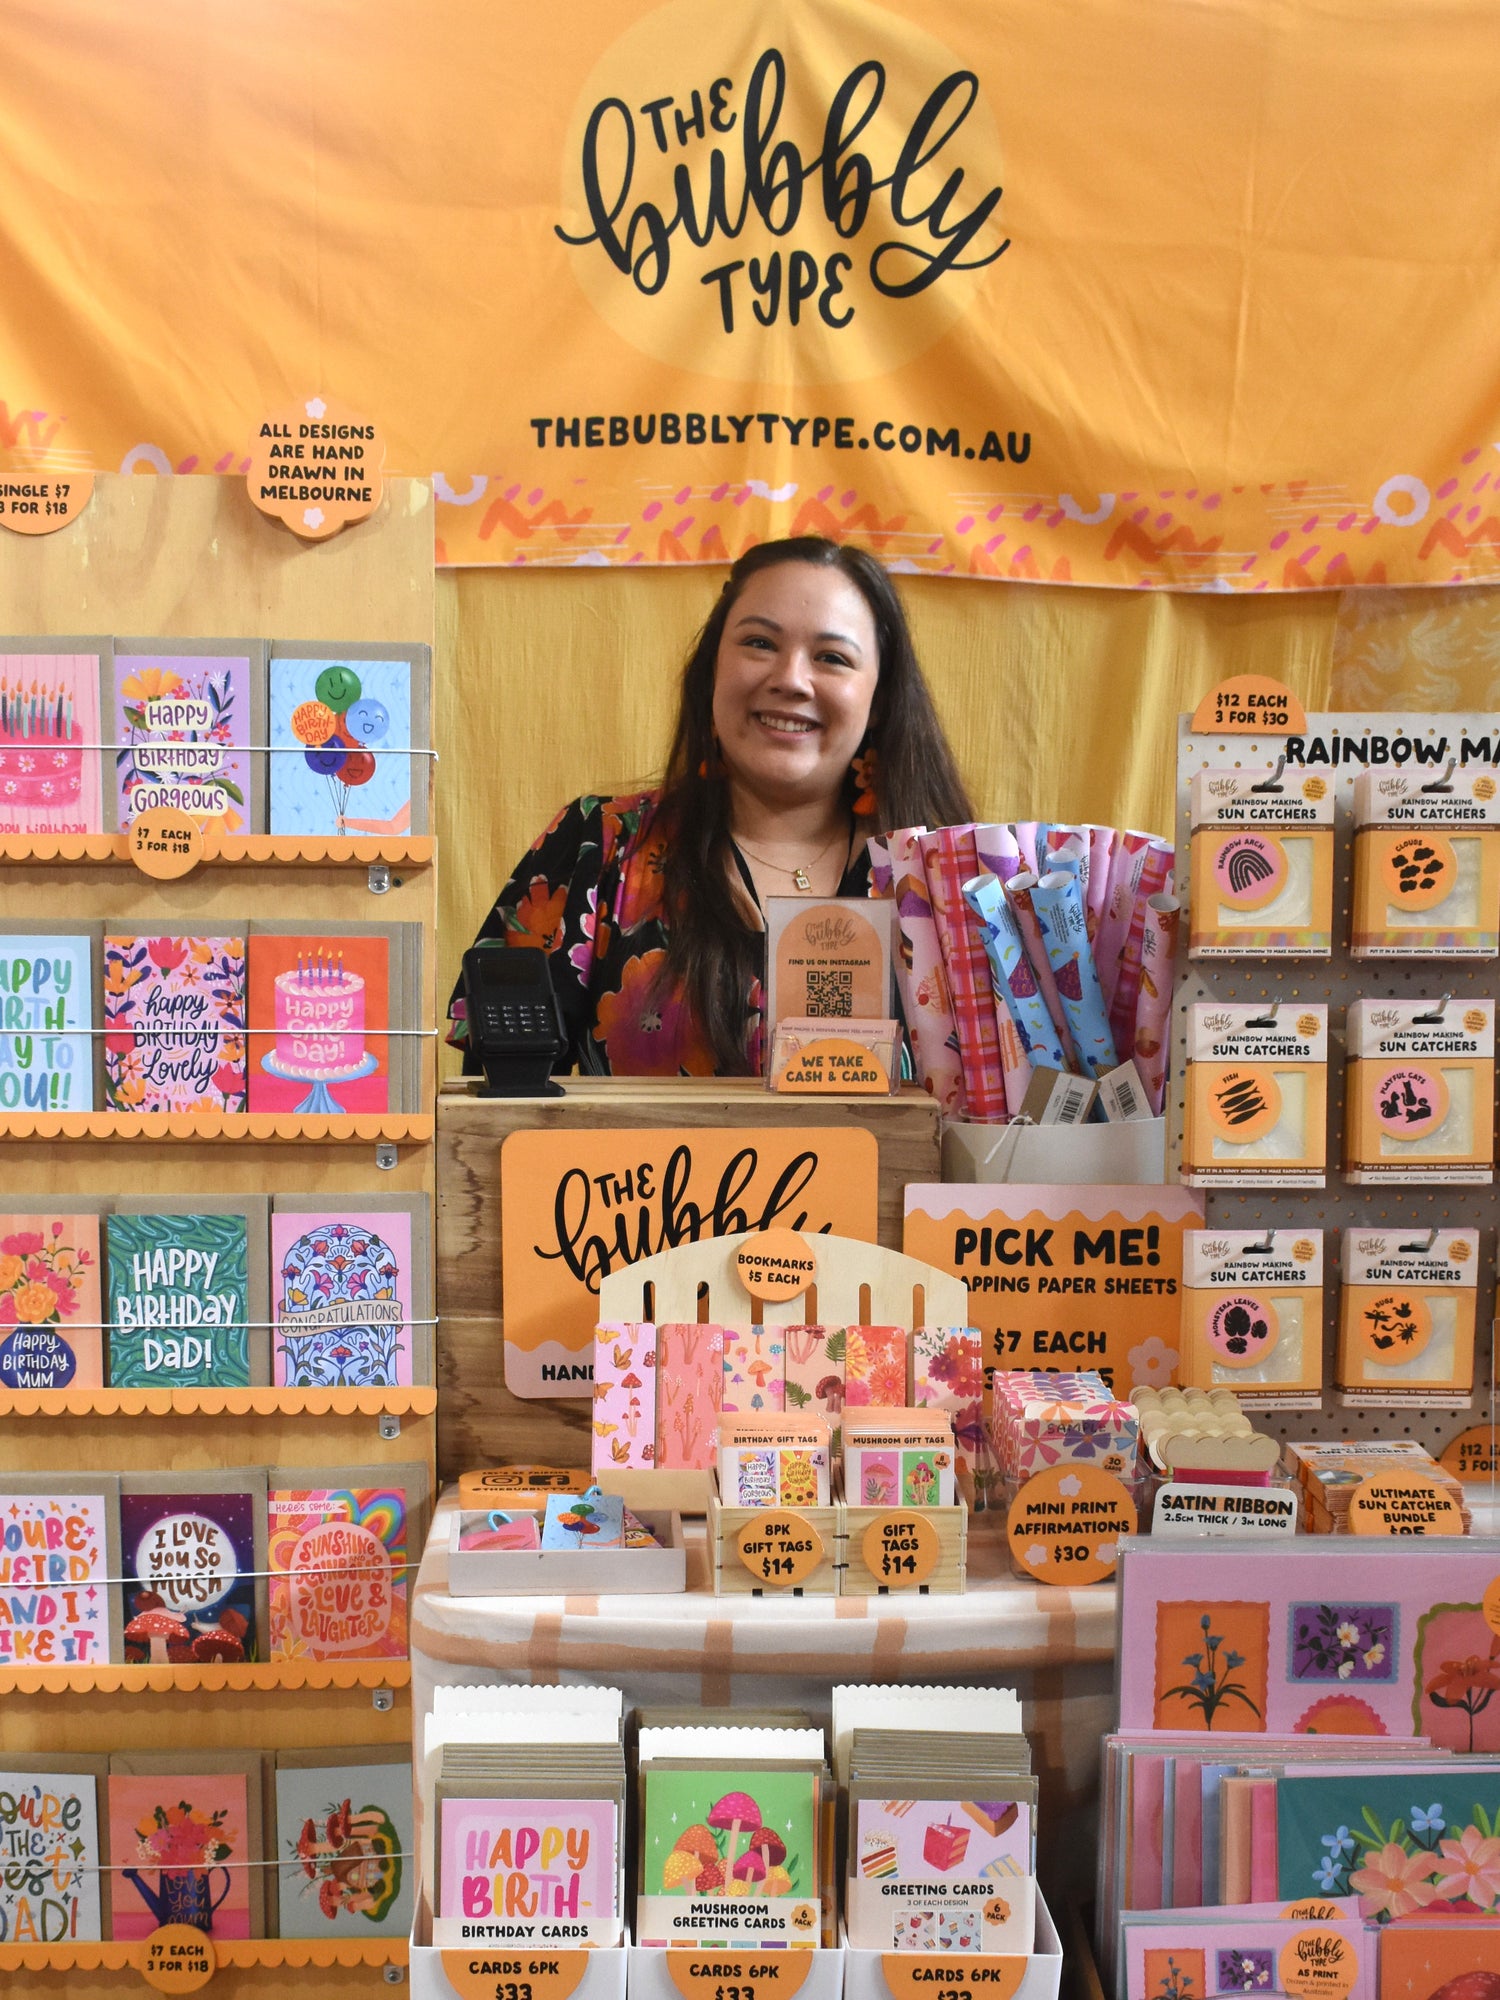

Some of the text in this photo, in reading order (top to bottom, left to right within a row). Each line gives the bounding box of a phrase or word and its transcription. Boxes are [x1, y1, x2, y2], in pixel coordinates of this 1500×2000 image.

[641, 77, 736, 152] THE
[555, 48, 1010, 298] bubbly
[702, 250, 855, 333] TYPE
[259, 423, 374, 440] ALL DESIGNS
[531, 413, 1031, 463] THEBUBBLYTYPE.COM.AU
[269, 444, 364, 460] ARE HAND
[267, 465, 364, 481] DRAWN IN
[55, 483, 70, 499] $7
[259, 486, 372, 503] MELBOURNE
[11, 500, 68, 516] FOR $18
[1216, 693, 1288, 708] $12 EACH
[1215, 710, 1289, 727] 3 FOR $30
[1286, 736, 1448, 764] RAINBOW
[1217, 808, 1317, 819] SUN CATCHERS
[1387, 808, 1486, 819] SUN CATCHERS
[137, 826, 191, 840] $7 EACH
[136, 840, 190, 854] 3 FOR $18
[144, 986, 209, 1020] happy
[41, 1036, 74, 1070] TO
[1212, 1045, 1310, 1056] SUN CATCHERS
[1379, 1041, 1477, 1052] SUN CATCHERS
[801, 1055, 864, 1068] WE TAKE
[786, 1070, 878, 1082] CASH & CARD
[1222, 1073, 1239, 1084] FISH
[594, 1163, 656, 1208] THE
[954, 1225, 1162, 1266] PICK ME!
[133, 1248, 220, 1291] HAPPY
[738, 1254, 814, 1272] BOOKMARKS
[748, 1269, 801, 1285] $5 EACH
[1210, 1270, 1306, 1281] SUN CATCHERS
[1365, 1269, 1461, 1280] SUN CATCHERS
[1038, 1276, 1177, 1295] PAPER SHEETS
[281, 1303, 399, 1331] CONGRATULATIONS
[993, 1328, 1106, 1355] $7 EACH
[3, 1352, 70, 1376] BIRTHDAY
[18, 1371, 54, 1389] MUM
[733, 1436, 818, 1444] BIRTHDAY GIFT TAGS
[925, 1436, 945, 1444] TAGS
[1109, 1456, 1121, 1466] 30
[1370, 1488, 1435, 1499] ULTIMATE
[1026, 1500, 1118, 1515] MINI PRINT
[1161, 1494, 1293, 1516] SATIN RIBBON
[1358, 1501, 1452, 1511] SUN CATCHER
[1197, 1514, 1228, 1525] THICK
[1231, 1516, 1238, 1526] /
[1258, 1517, 1287, 1528] LONG
[1383, 1512, 1436, 1523] BUNDLE
[155, 1521, 218, 1549] I LOVE
[765, 1524, 790, 1536] 8PK
[883, 1524, 915, 1537] GIFT
[1013, 1519, 1130, 1535] AFFIRMATIONS
[743, 1541, 813, 1554] GIFT TAGS
[882, 1539, 919, 1552] TAGS
[1054, 1545, 1090, 1563] $30
[762, 1557, 795, 1577] $14
[882, 1554, 917, 1575] $14
[368, 1583, 388, 1608] &
[62, 1591, 80, 1623] I
[62, 1630, 94, 1661] IT
[4, 1829, 44, 1857] THE
[464, 1826, 590, 1872] HAPPY
[881, 1884, 994, 1896] GREETING CARDS
[690, 1903, 769, 1916] MUSHROOM
[672, 1916, 786, 1930] GREETING CARDS
[461, 1925, 589, 1939] BIRTHDAY CARDS
[151, 1944, 204, 1958] $7 EACH
[147, 1959, 209, 1973] 3 FOR $18
[468, 1960, 560, 1976] CARDS 6PK
[689, 1963, 779, 1978] CARDS 6PK
[912, 1968, 1001, 1982] CARDS 6PK
[1313, 1970, 1339, 1979] PRINT
